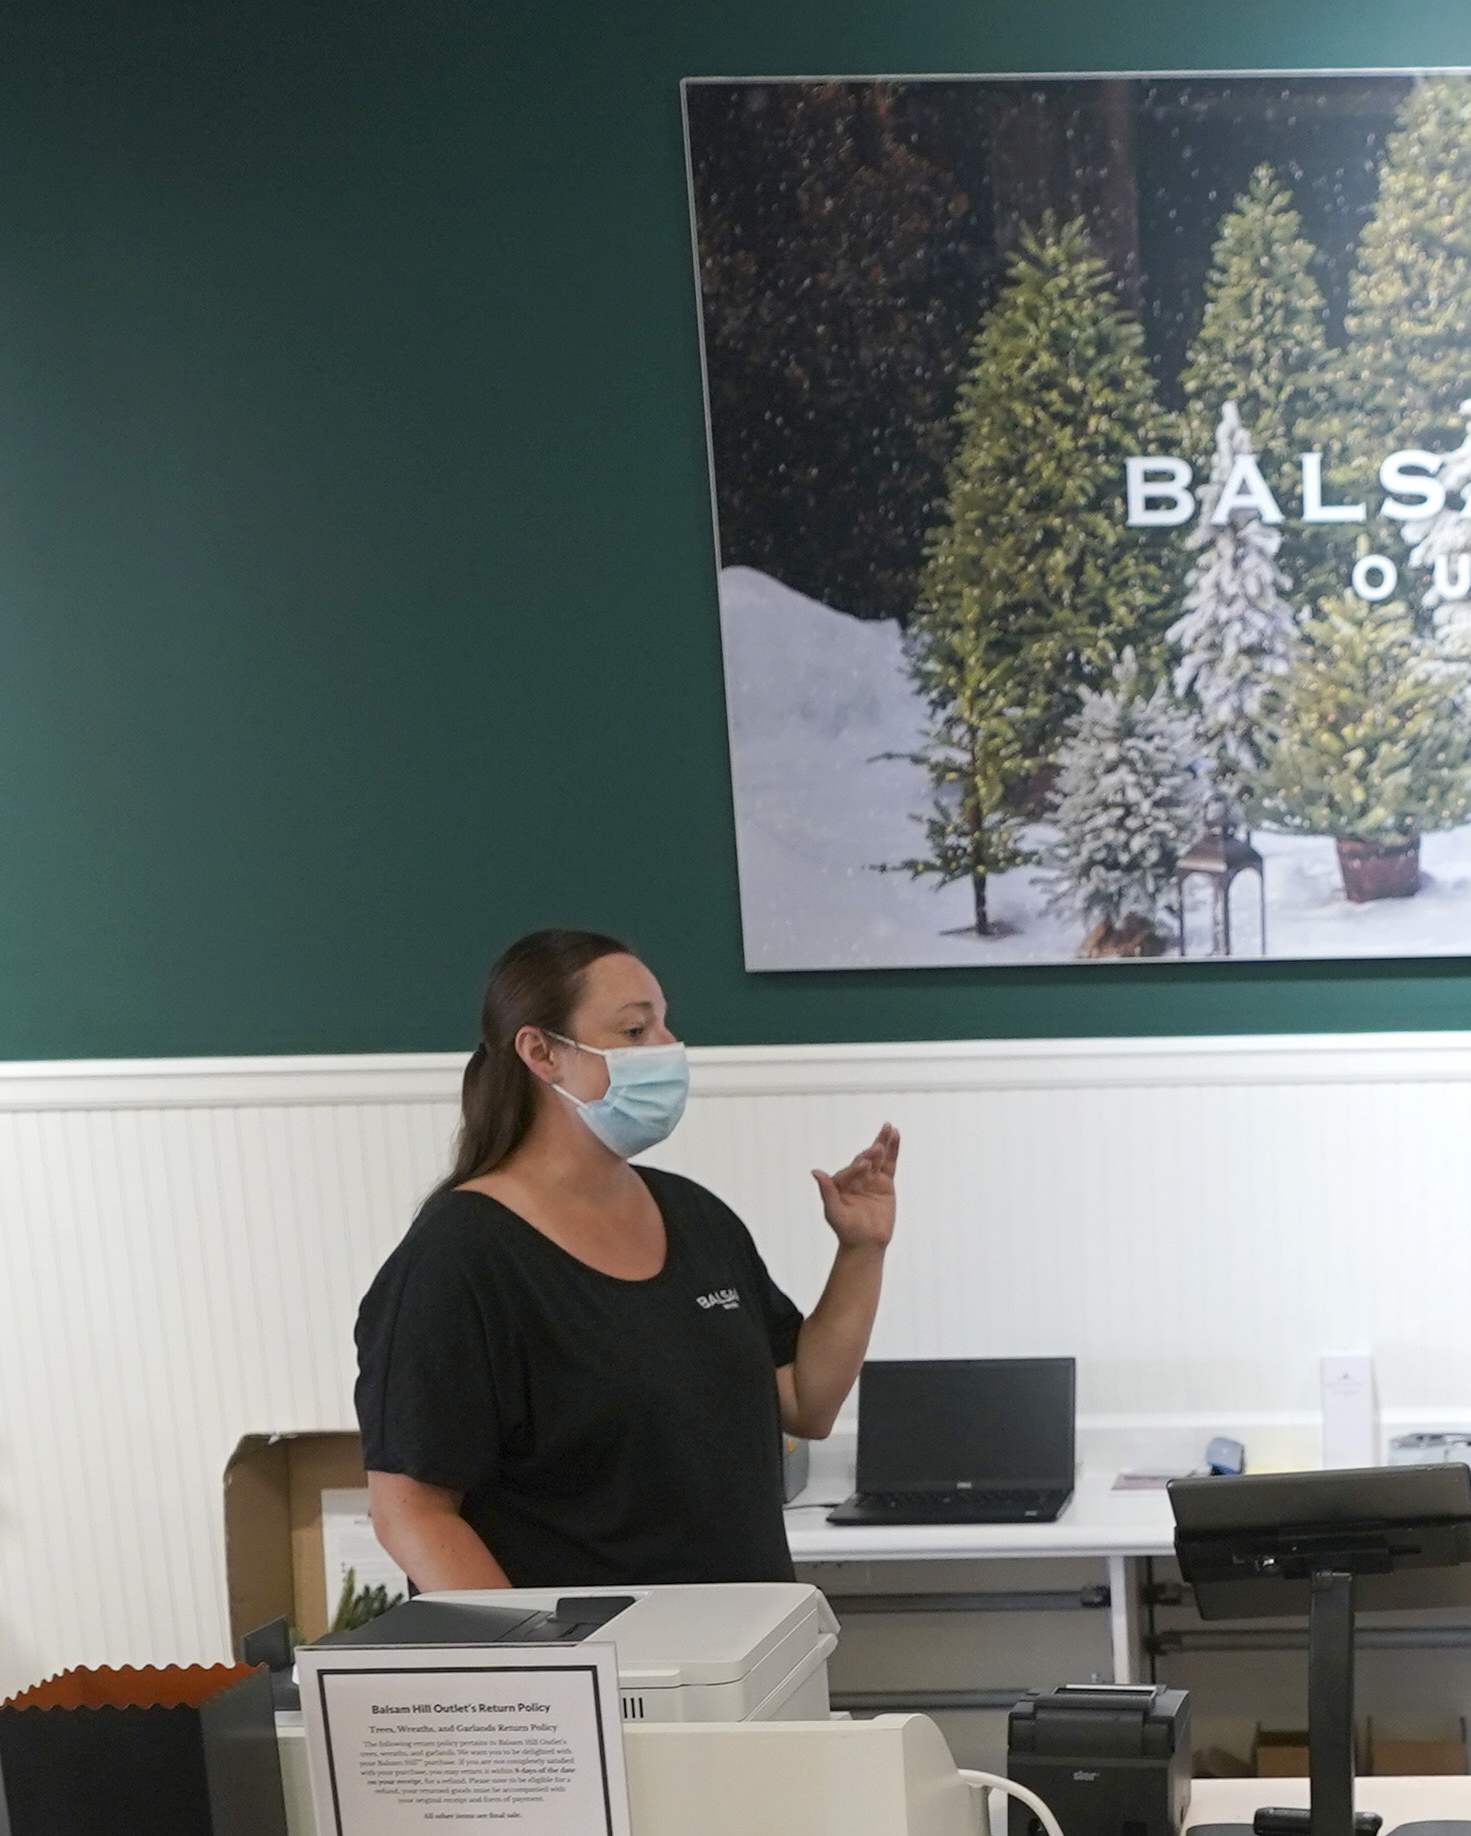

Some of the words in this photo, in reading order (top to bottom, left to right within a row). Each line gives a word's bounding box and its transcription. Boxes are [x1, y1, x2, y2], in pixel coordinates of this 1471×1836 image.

[372, 1705, 410, 1714] Balsam
[413, 1704, 431, 1713] Hill
[434, 1704, 476, 1713] Outlet's
[479, 1704, 515, 1712] Return
[518, 1703, 551, 1713] Policy
